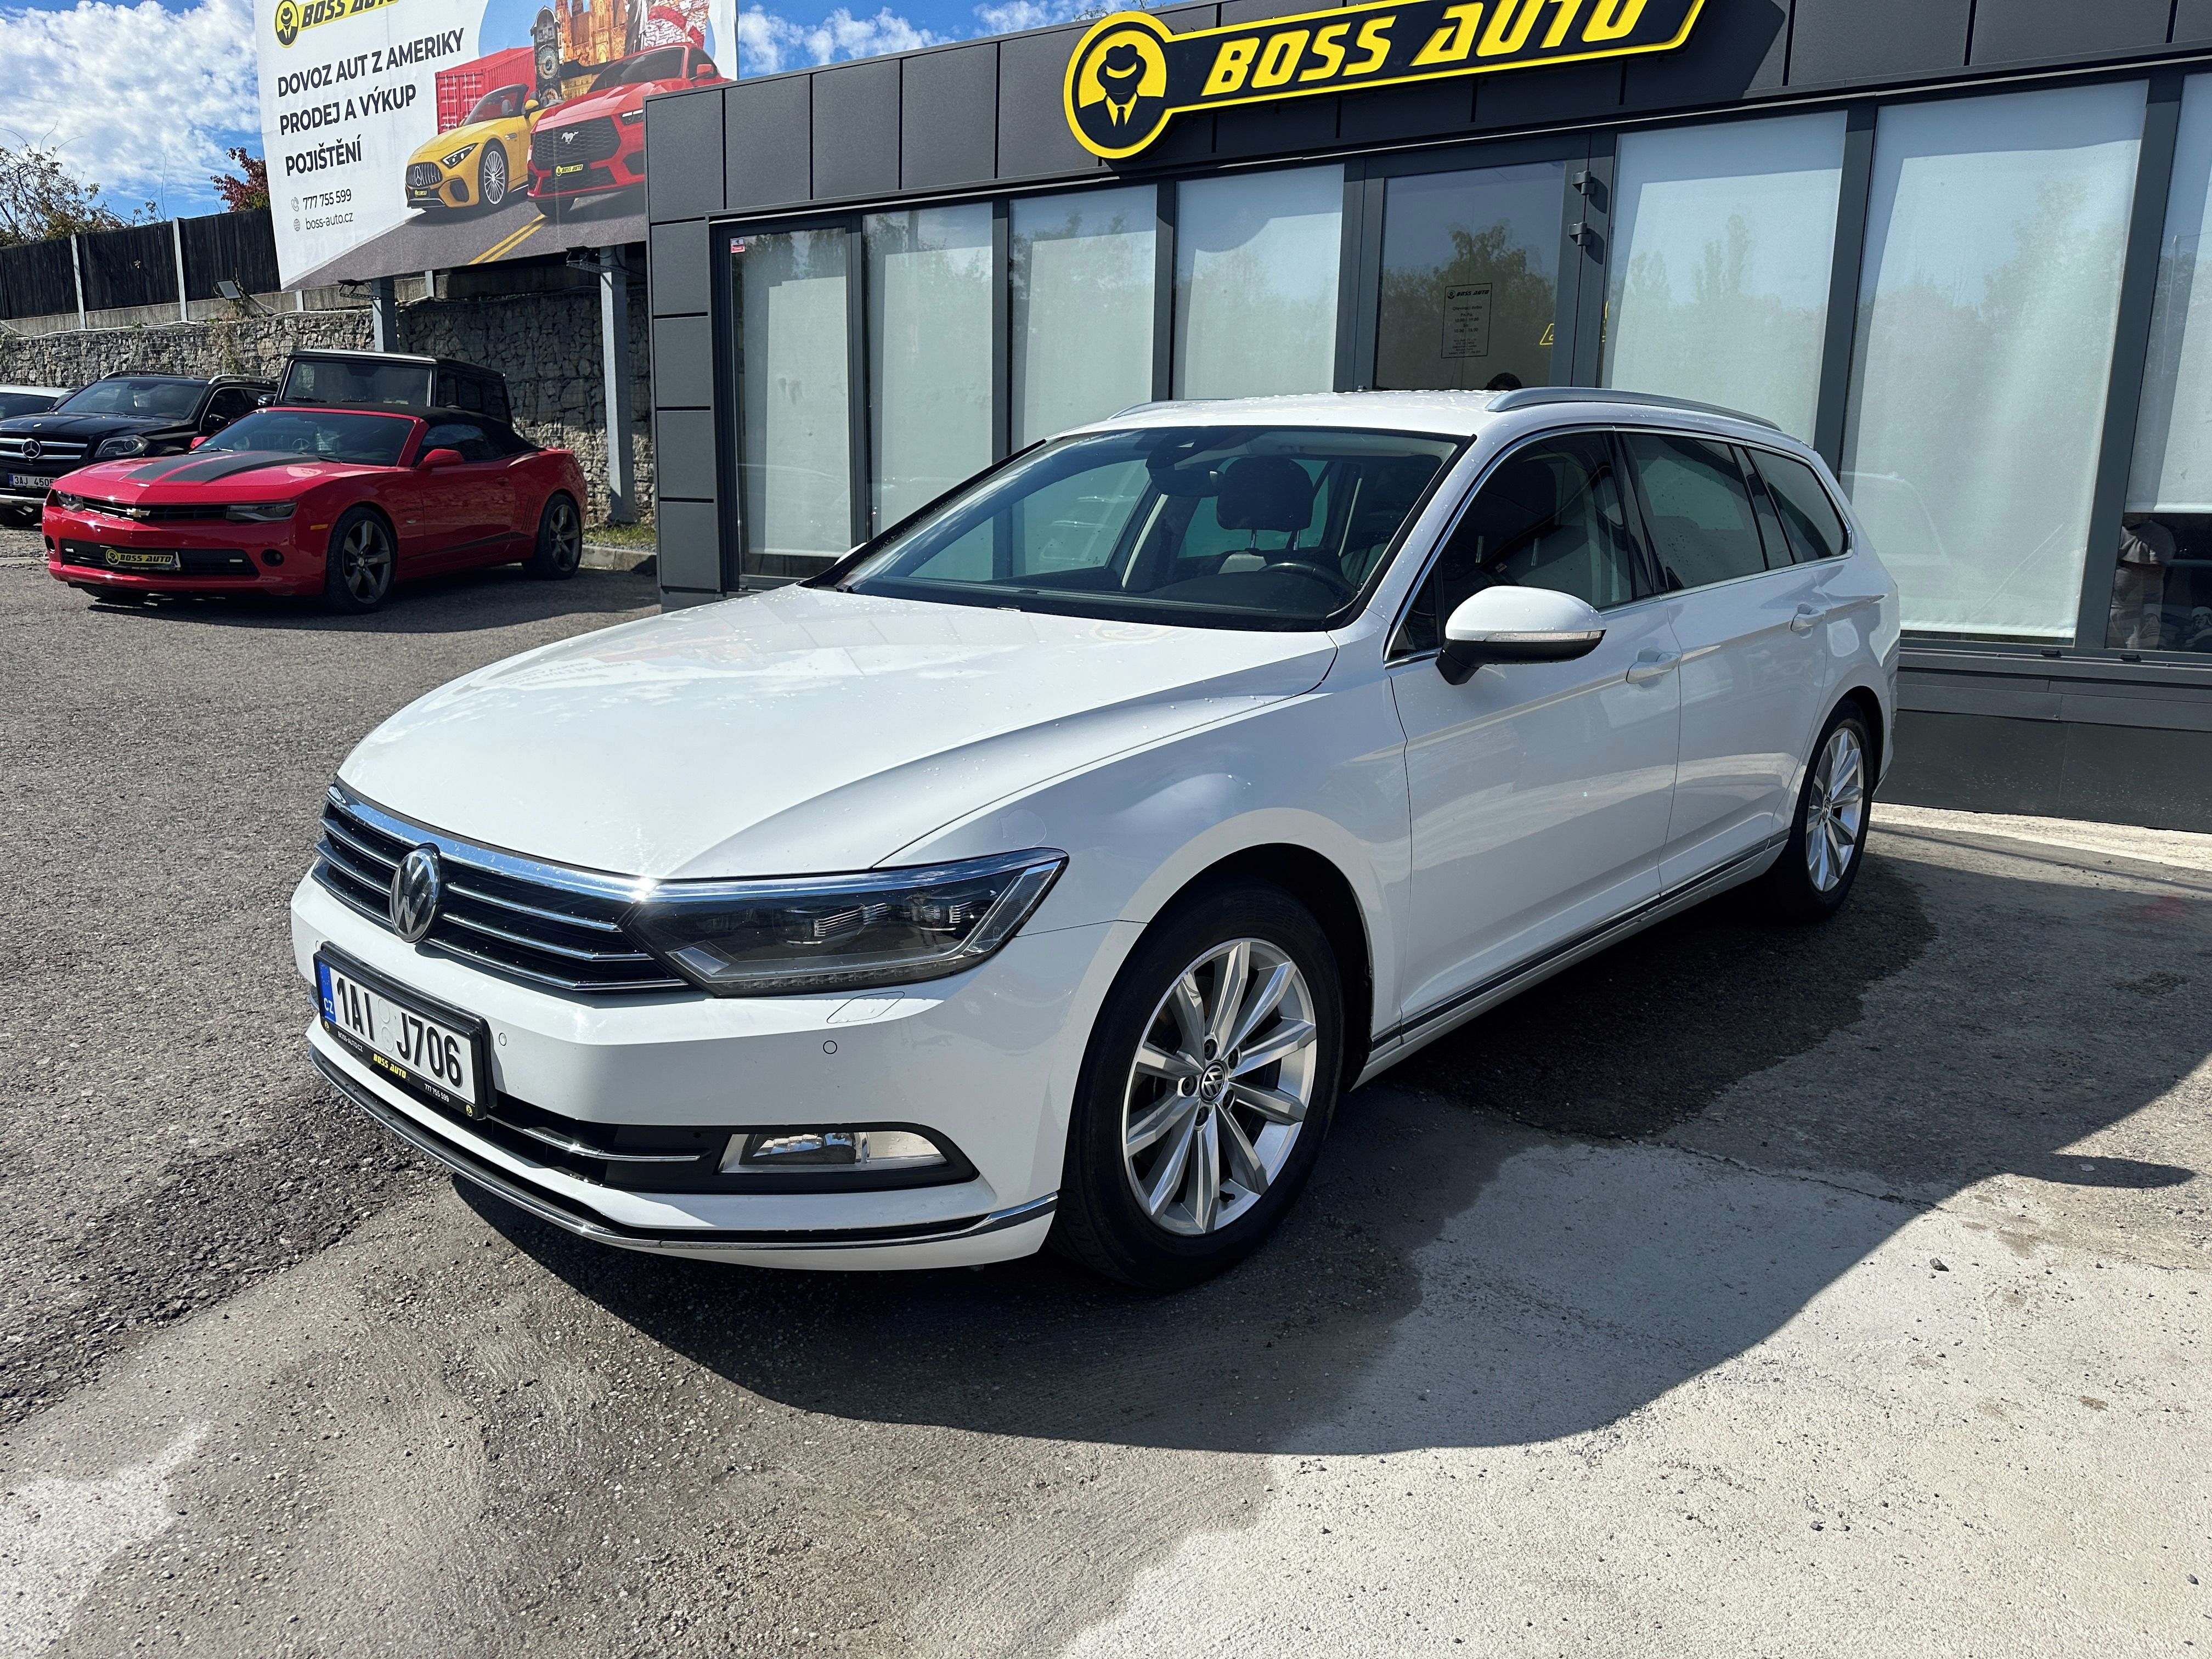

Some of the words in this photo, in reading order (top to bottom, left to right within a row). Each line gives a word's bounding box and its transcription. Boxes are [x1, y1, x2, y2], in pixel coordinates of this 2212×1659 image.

[301, 0, 346, 27] BOSS
[278, 64, 332, 97] DOVOZ
[336, 54, 368, 83] AUT
[371, 50, 382, 74] Z
[386, 27, 464, 70] AMERIKY
[1201, 15, 1397, 97] BOSS
[280, 101, 340, 136] PRODEJ
[345, 99, 357, 121] A
[359, 84, 416, 116] VÝKUP
[285, 134, 362, 176] POJIŠTĚNÍ
[303, 195, 318, 210] 777
[319, 192, 334, 207] 755
[336, 189, 352, 204] 599
[306, 212, 354, 230] boss-auto.cz
[14, 476, 28, 485] 3AJ
[324, 997, 334, 1014] CZ
[336, 977, 375, 1041] 1AI
[396, 1011, 463, 1087] J706
[373, 1053, 388, 1069] BOSS
[390, 1063, 407, 1079] AUTO
